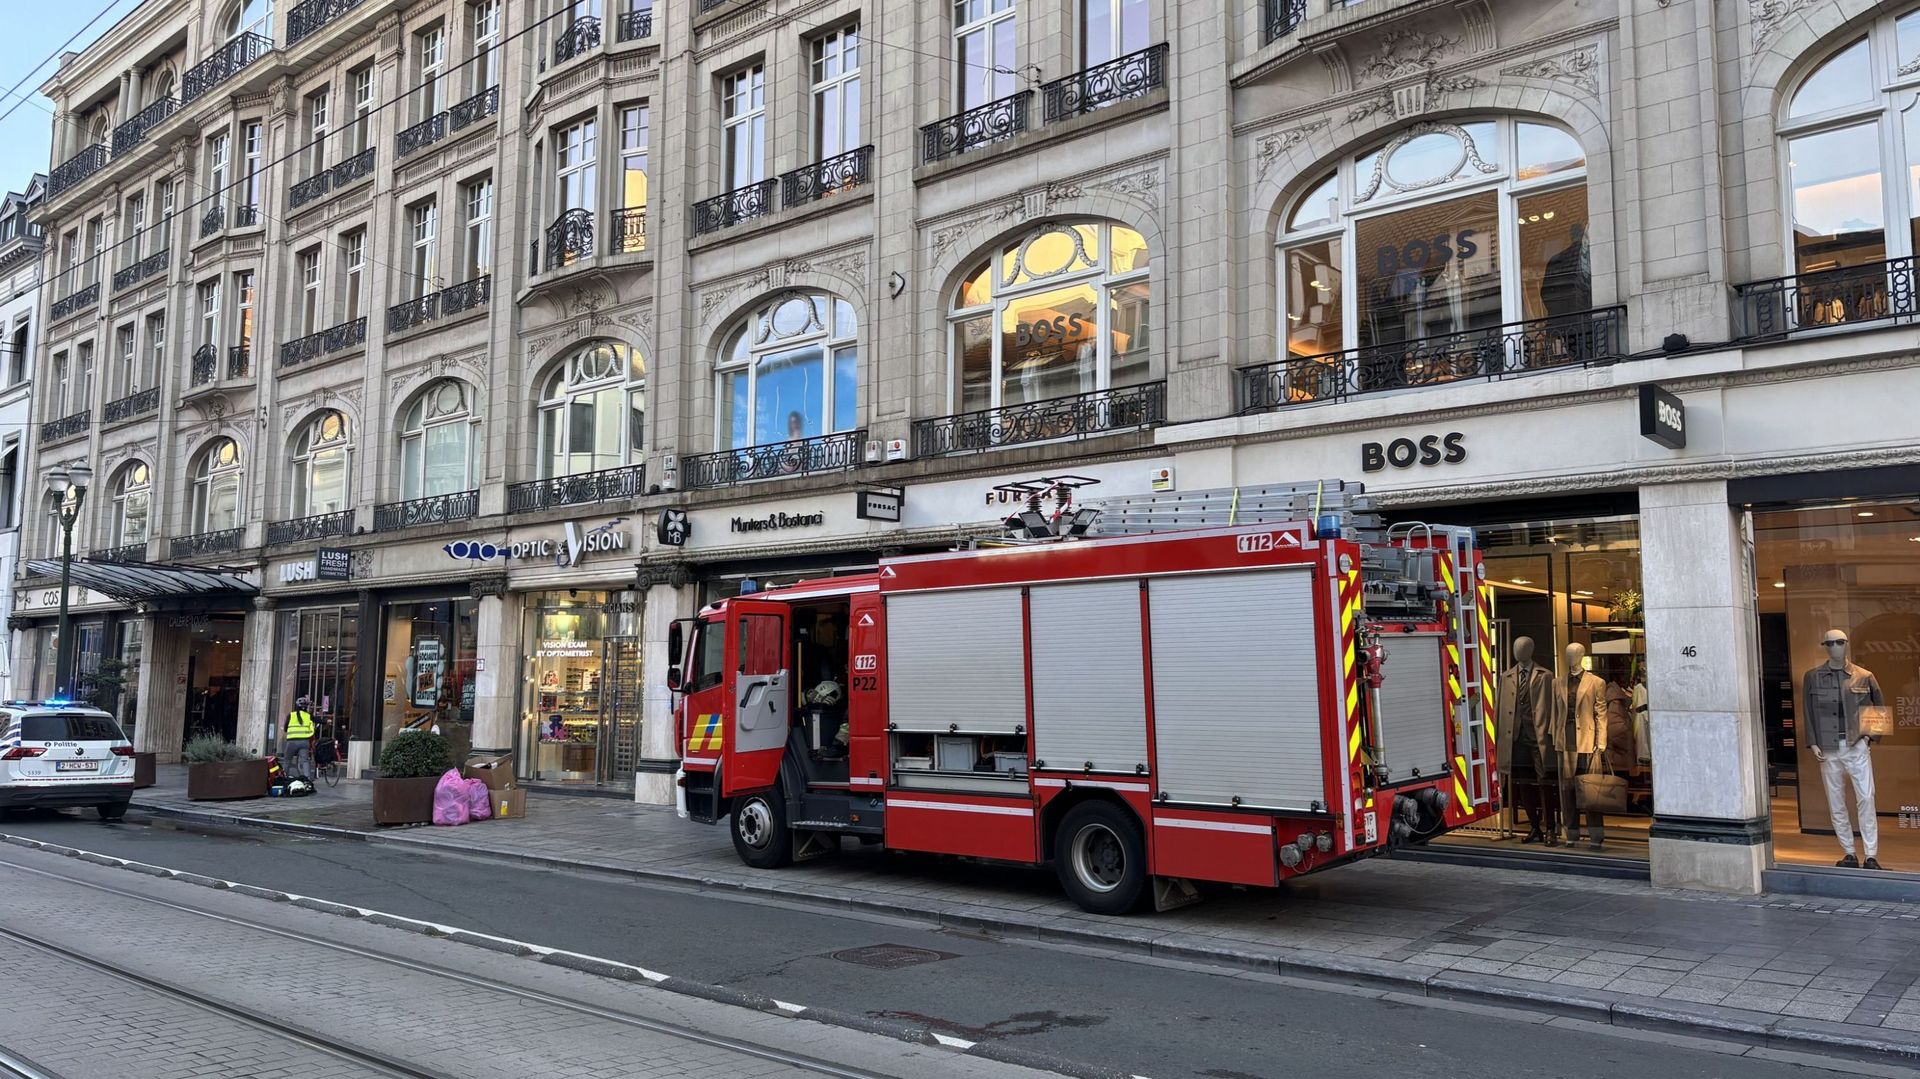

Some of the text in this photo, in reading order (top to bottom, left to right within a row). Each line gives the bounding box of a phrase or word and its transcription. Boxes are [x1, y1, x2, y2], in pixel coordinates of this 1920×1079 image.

[1377, 230, 1477, 274] BOSS
[1016, 313, 1082, 346] BOSS
[1658, 400, 1683, 432] BOSS
[1362, 432, 1468, 472] BOSS
[985, 487, 1053, 506] FURA
[868, 502, 896, 511] FURSAC
[512, 521, 626, 568] OPTIC & VISION
[667, 531, 682, 544] MB
[1246, 534, 1271, 552] 112
[321, 552, 348, 561] LUSH
[321, 559, 348, 568] FRESH
[280, 561, 316, 582] LUSH
[43, 590, 60, 606] COS
[1681, 645, 1697, 658] 46
[859, 656, 875, 668] 112
[852, 676, 877, 691] P22
